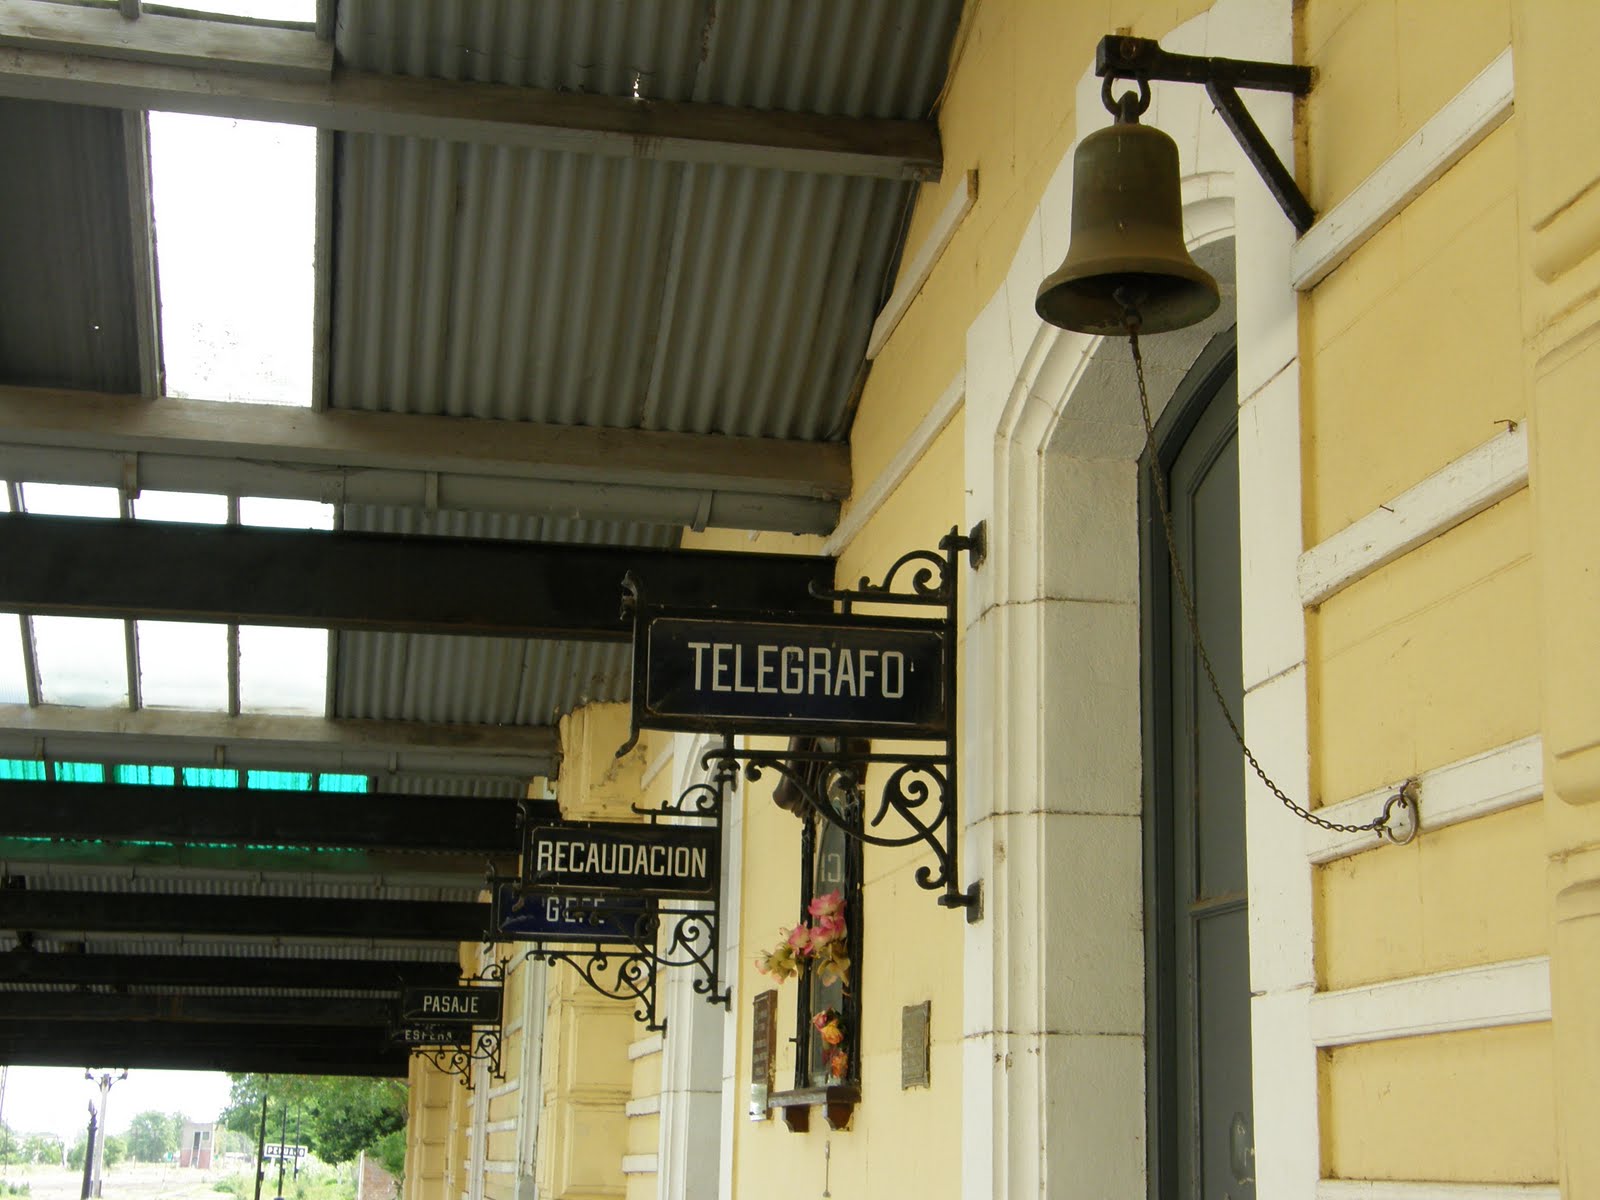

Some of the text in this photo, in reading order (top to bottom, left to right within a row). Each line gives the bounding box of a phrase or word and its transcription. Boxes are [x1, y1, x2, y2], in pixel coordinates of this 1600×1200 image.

[688, 642, 904, 699] TELEGRAFO
[537, 840, 706, 878] RECAUDACION
[423, 995, 479, 1013] PASAJE
[268, 1146, 304, 1156] PEUAO
